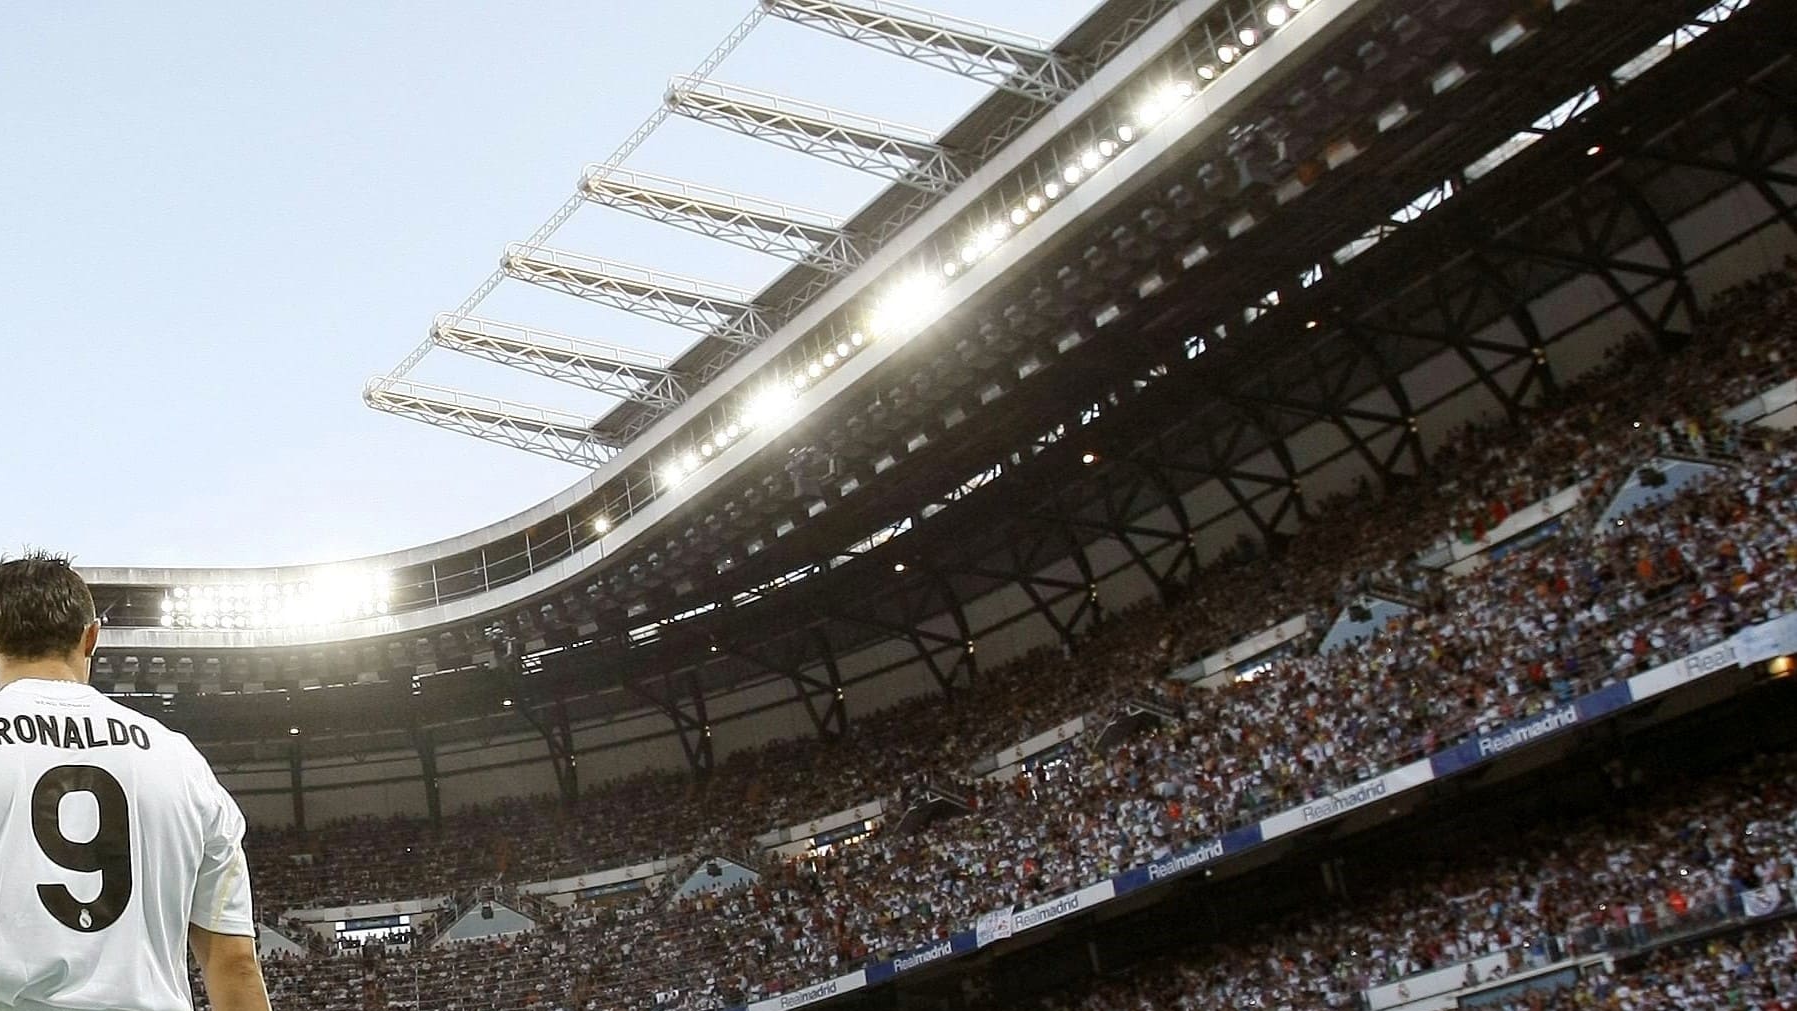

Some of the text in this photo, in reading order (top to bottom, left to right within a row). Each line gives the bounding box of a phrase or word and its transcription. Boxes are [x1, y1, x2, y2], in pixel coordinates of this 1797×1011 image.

[1479, 705, 1577, 757] Realmadrid
[1303, 781, 1386, 823] Realmadrid
[31, 764, 134, 933] 9
[1148, 840, 1224, 881] Realmadrid
[1015, 897, 1079, 930] Realmadrid
[894, 941, 952, 972] Realmadrid
[780, 982, 837, 1009] Realmadrid
